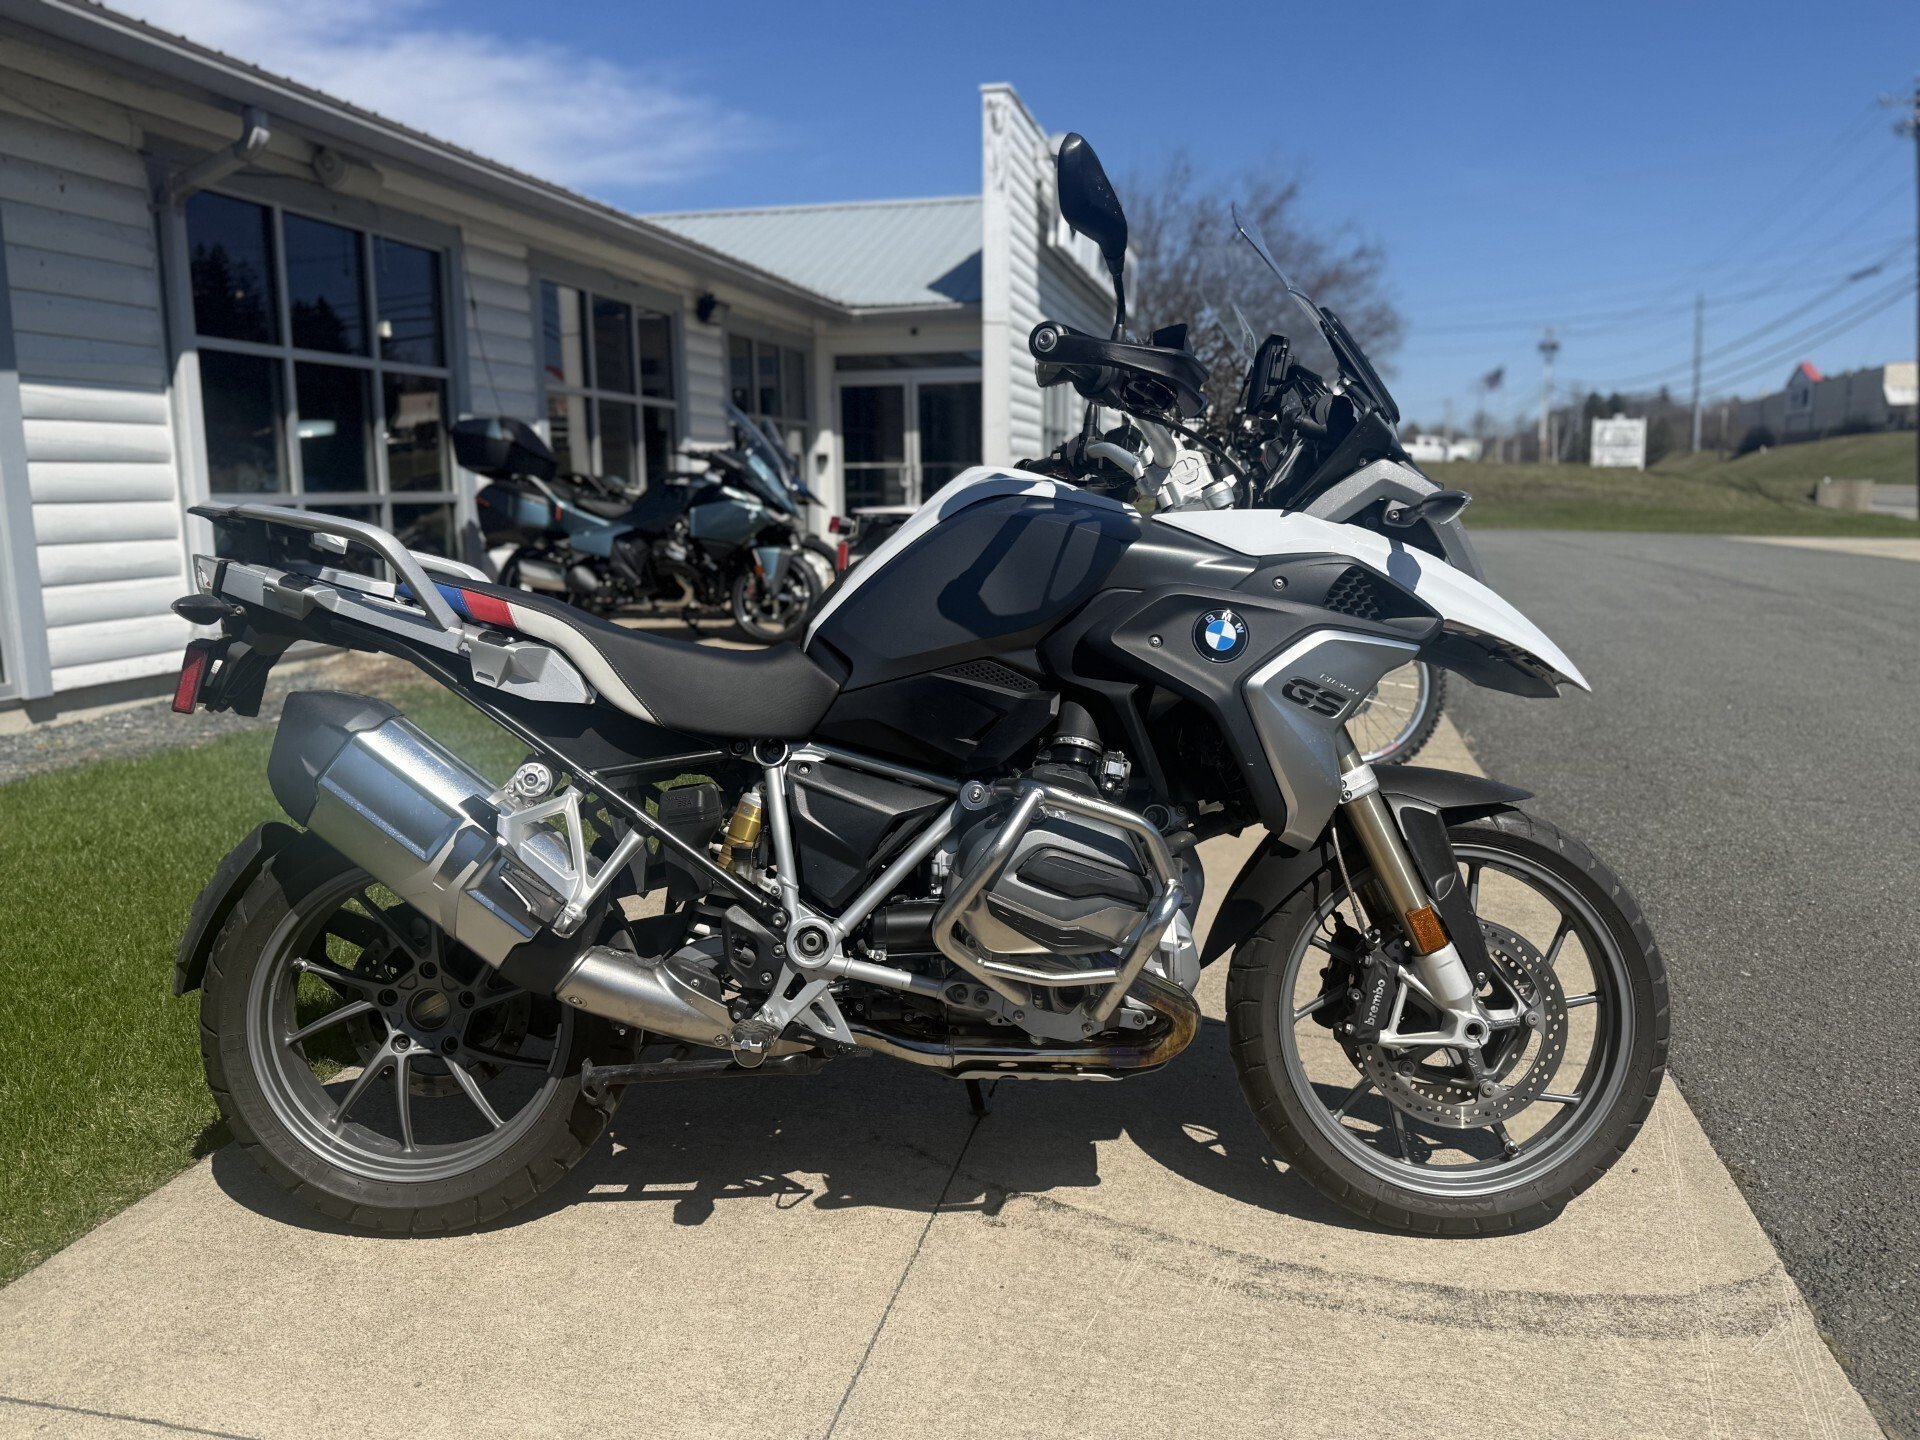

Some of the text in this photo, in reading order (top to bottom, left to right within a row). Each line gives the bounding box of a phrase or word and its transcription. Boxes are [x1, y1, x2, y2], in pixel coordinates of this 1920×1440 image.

[1205, 612, 1244, 633] BMW
[1282, 677, 1351, 718] GS
[1364, 979, 1386, 1026] brembo
